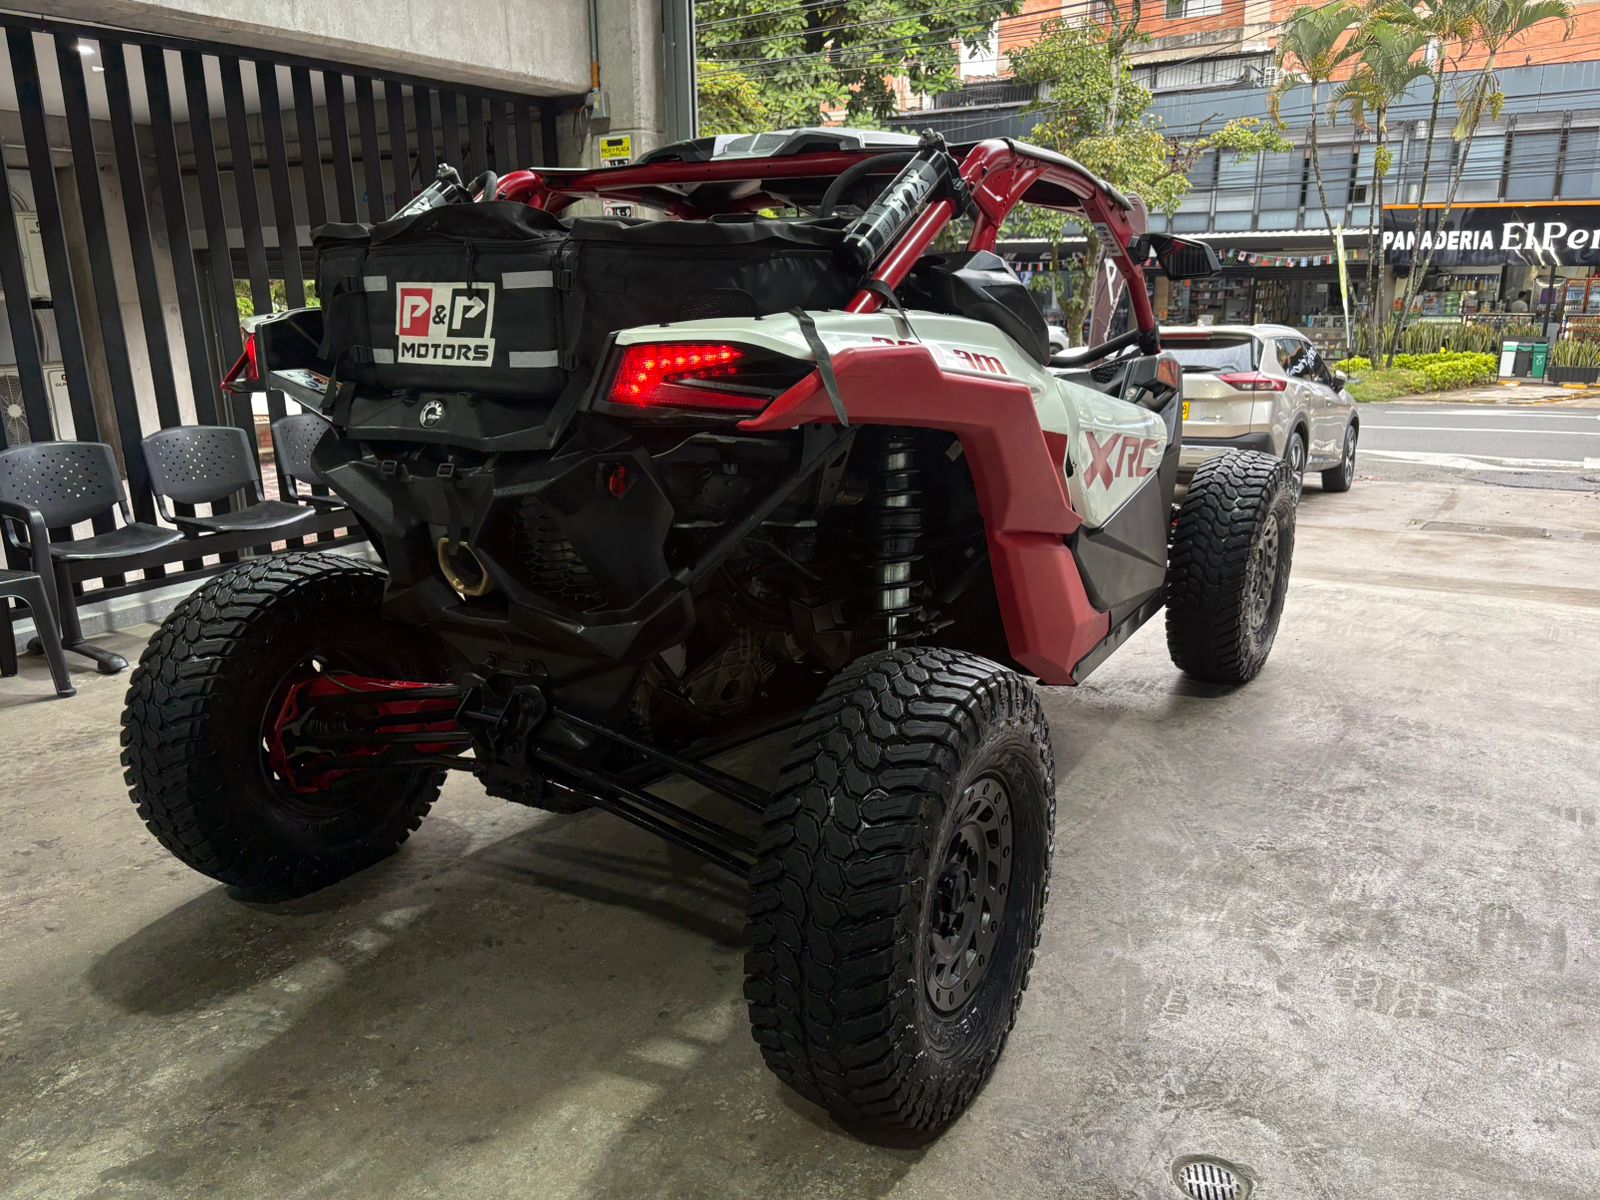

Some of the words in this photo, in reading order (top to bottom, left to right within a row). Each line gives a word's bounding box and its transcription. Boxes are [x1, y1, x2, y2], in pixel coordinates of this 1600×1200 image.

[882, 168, 931, 221] FOX
[1383, 230, 1494, 250] PANADERIA
[1501, 222, 1536, 250] El
[401, 342, 489, 361] MOTORS
[1083, 431, 1158, 491] XRC
